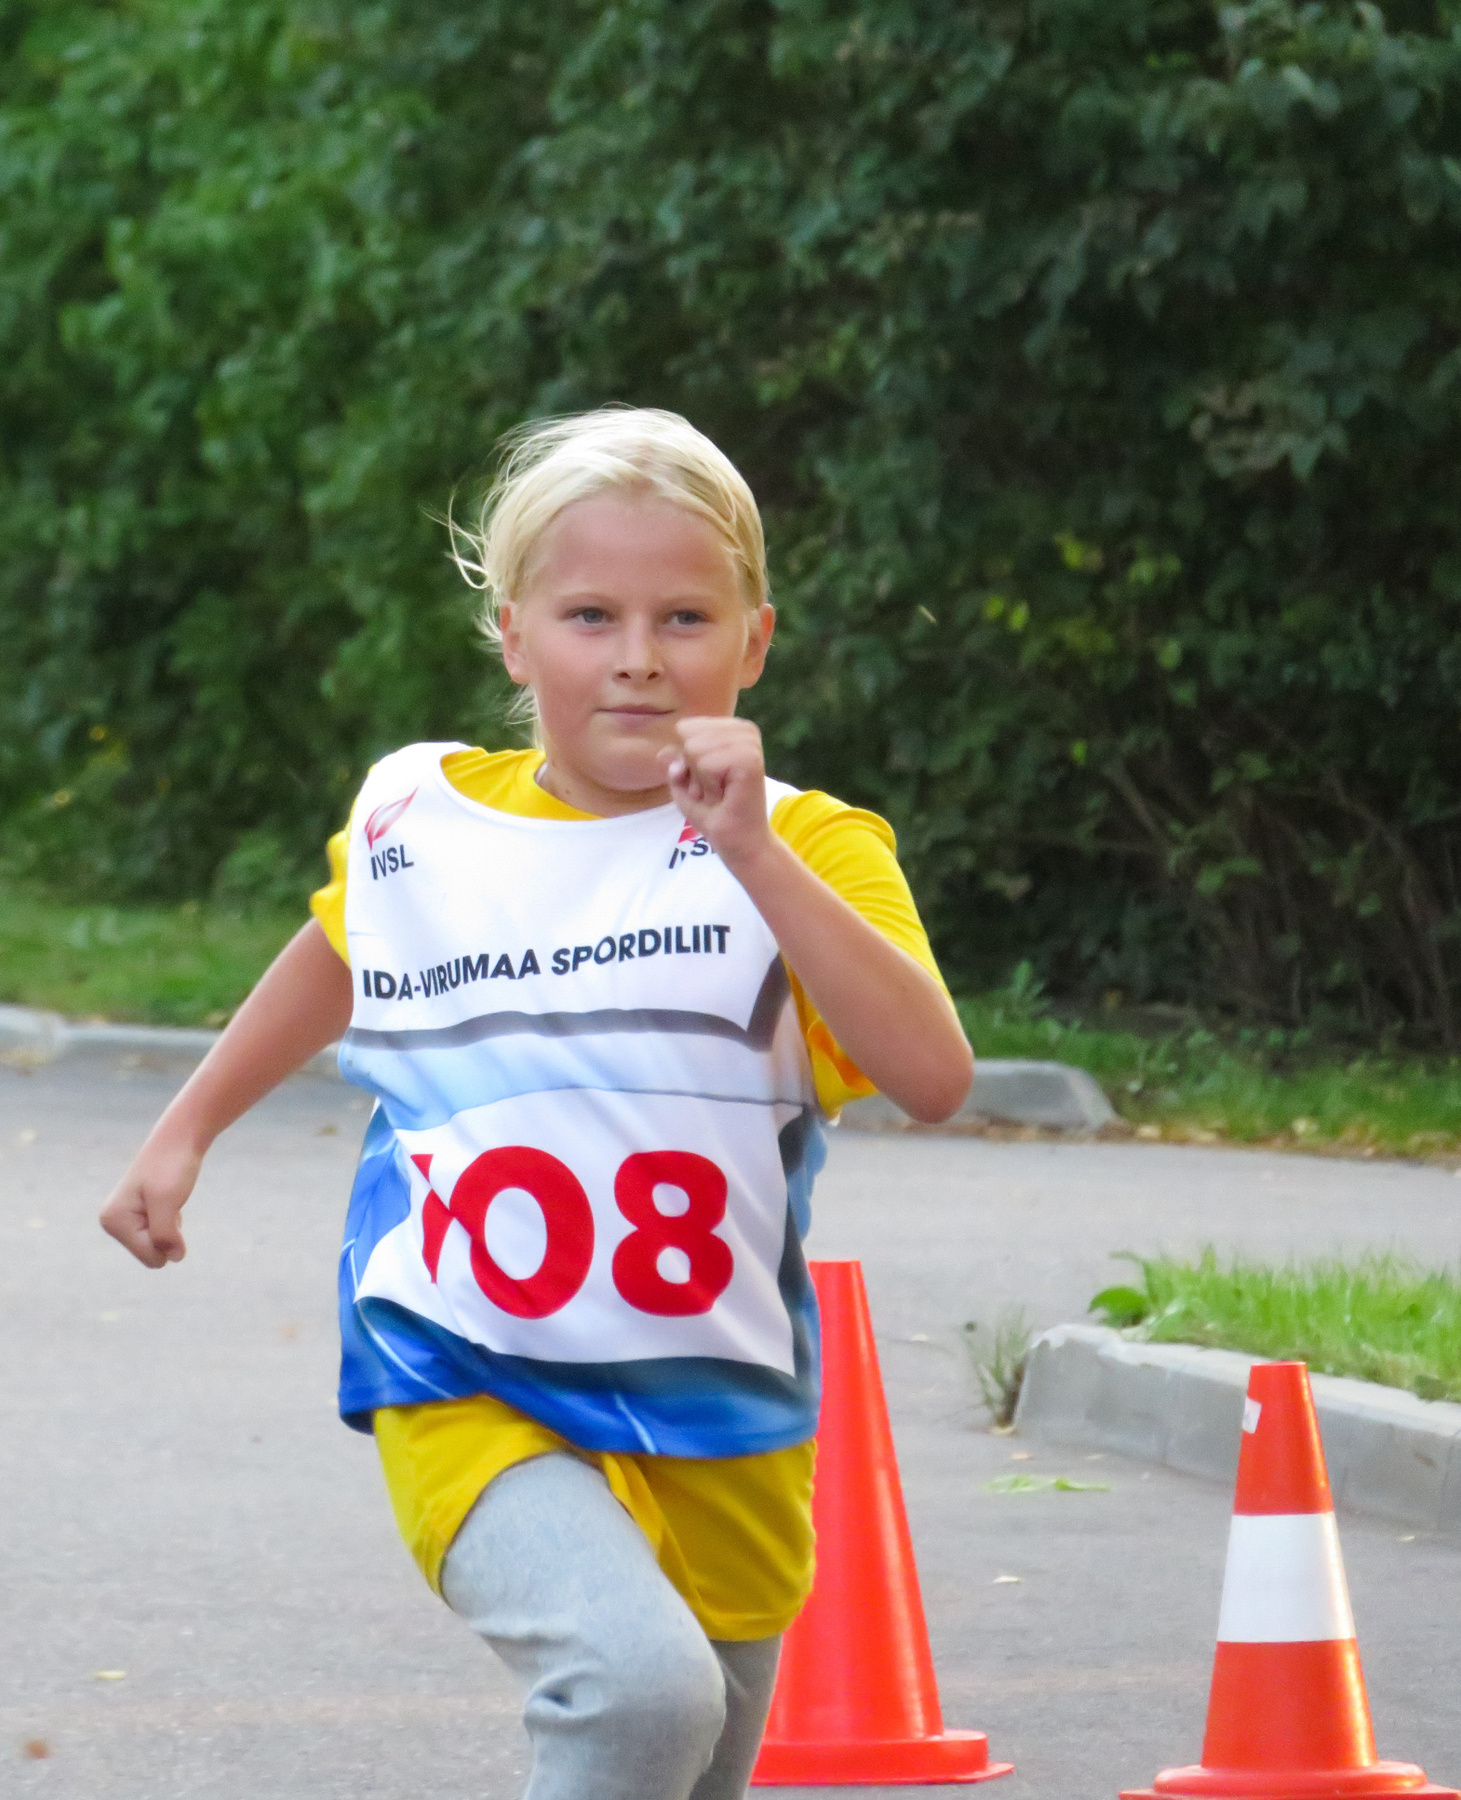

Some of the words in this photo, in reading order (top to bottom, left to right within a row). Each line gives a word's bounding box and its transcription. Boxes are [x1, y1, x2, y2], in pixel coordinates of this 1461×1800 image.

[371, 844, 415, 880] IVSL
[362, 948, 541, 1001] IDA-VIRUMAA
[551, 925, 731, 976] SPORDILIIT
